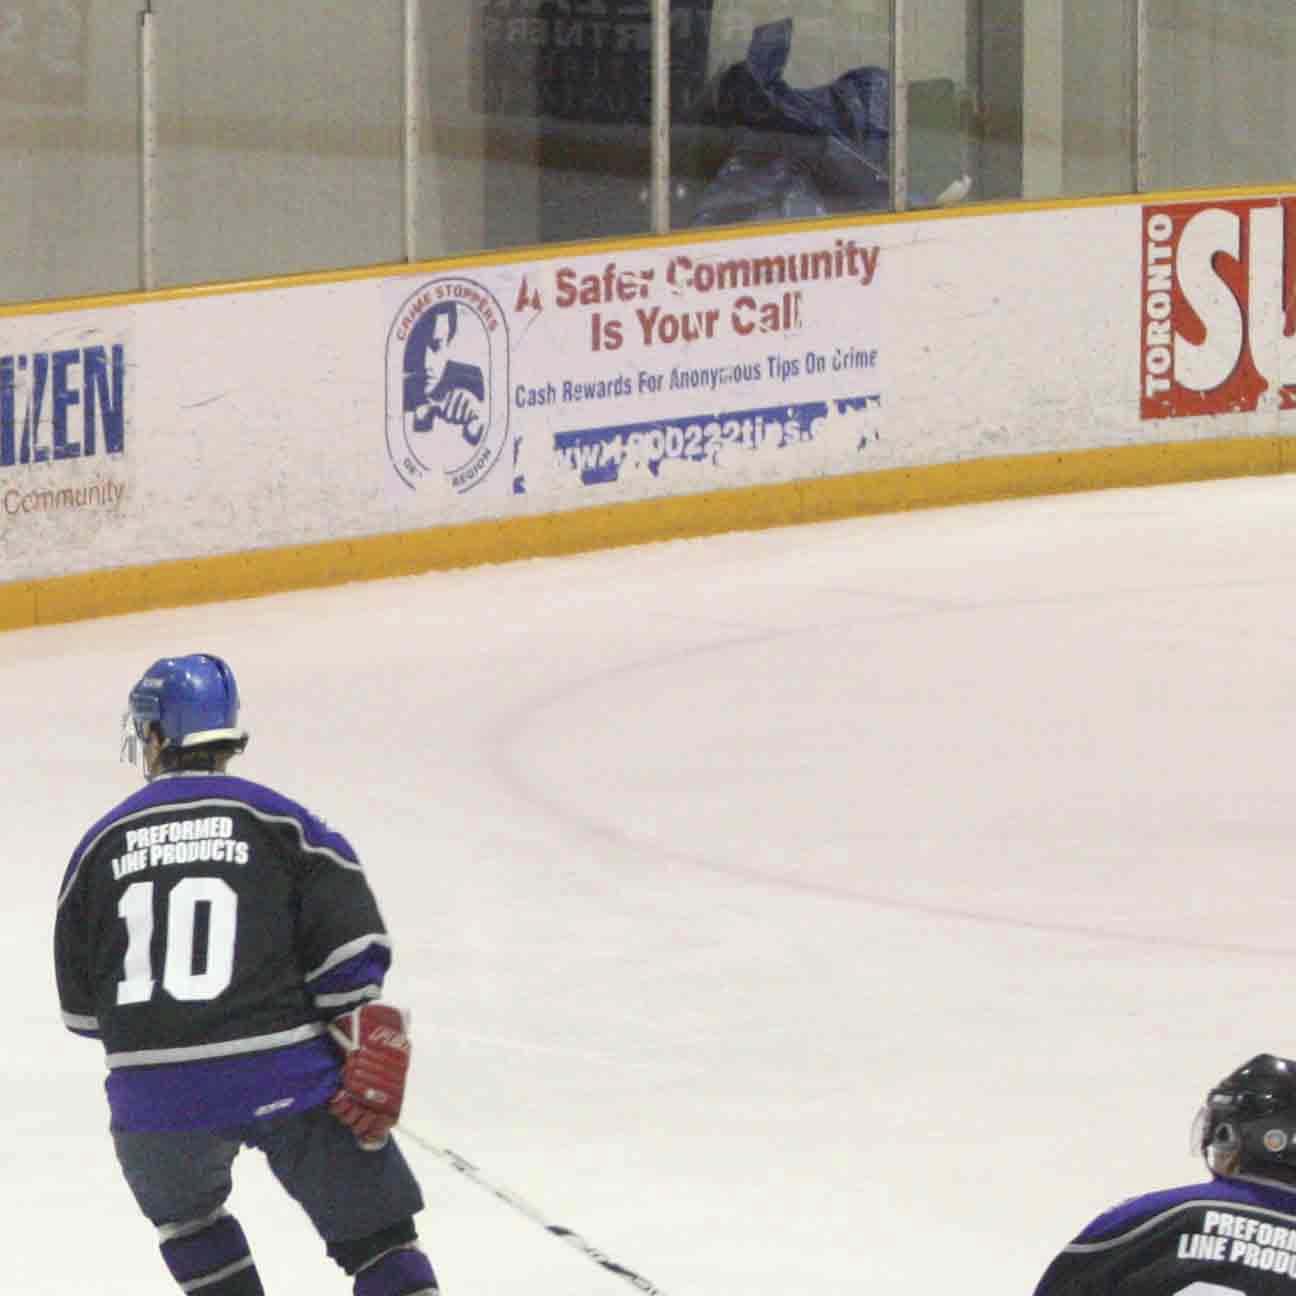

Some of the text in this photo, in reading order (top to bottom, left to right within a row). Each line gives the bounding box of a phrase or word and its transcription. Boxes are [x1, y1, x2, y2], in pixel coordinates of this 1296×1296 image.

[555, 262, 655, 307] Safer
[666, 239, 881, 297] Community
[434, 283, 498, 332] STOPPERS
[591, 291, 803, 352] Is Your Call
[1146, 213, 1174, 398] TORONTO
[515, 381, 557, 409] Cash
[562, 375, 633, 403] Rewards
[638, 371, 664, 394] For
[767, 355, 801, 383] Tips
[806, 352, 825, 375] On
[3, 477, 127, 515] Community
[125, 816, 235, 852] PREFORMED
[111, 841, 250, 881] LINE PRODUCTS
[115, 876, 239, 1005] 10
[1177, 1233, 1228, 1262] LINE
